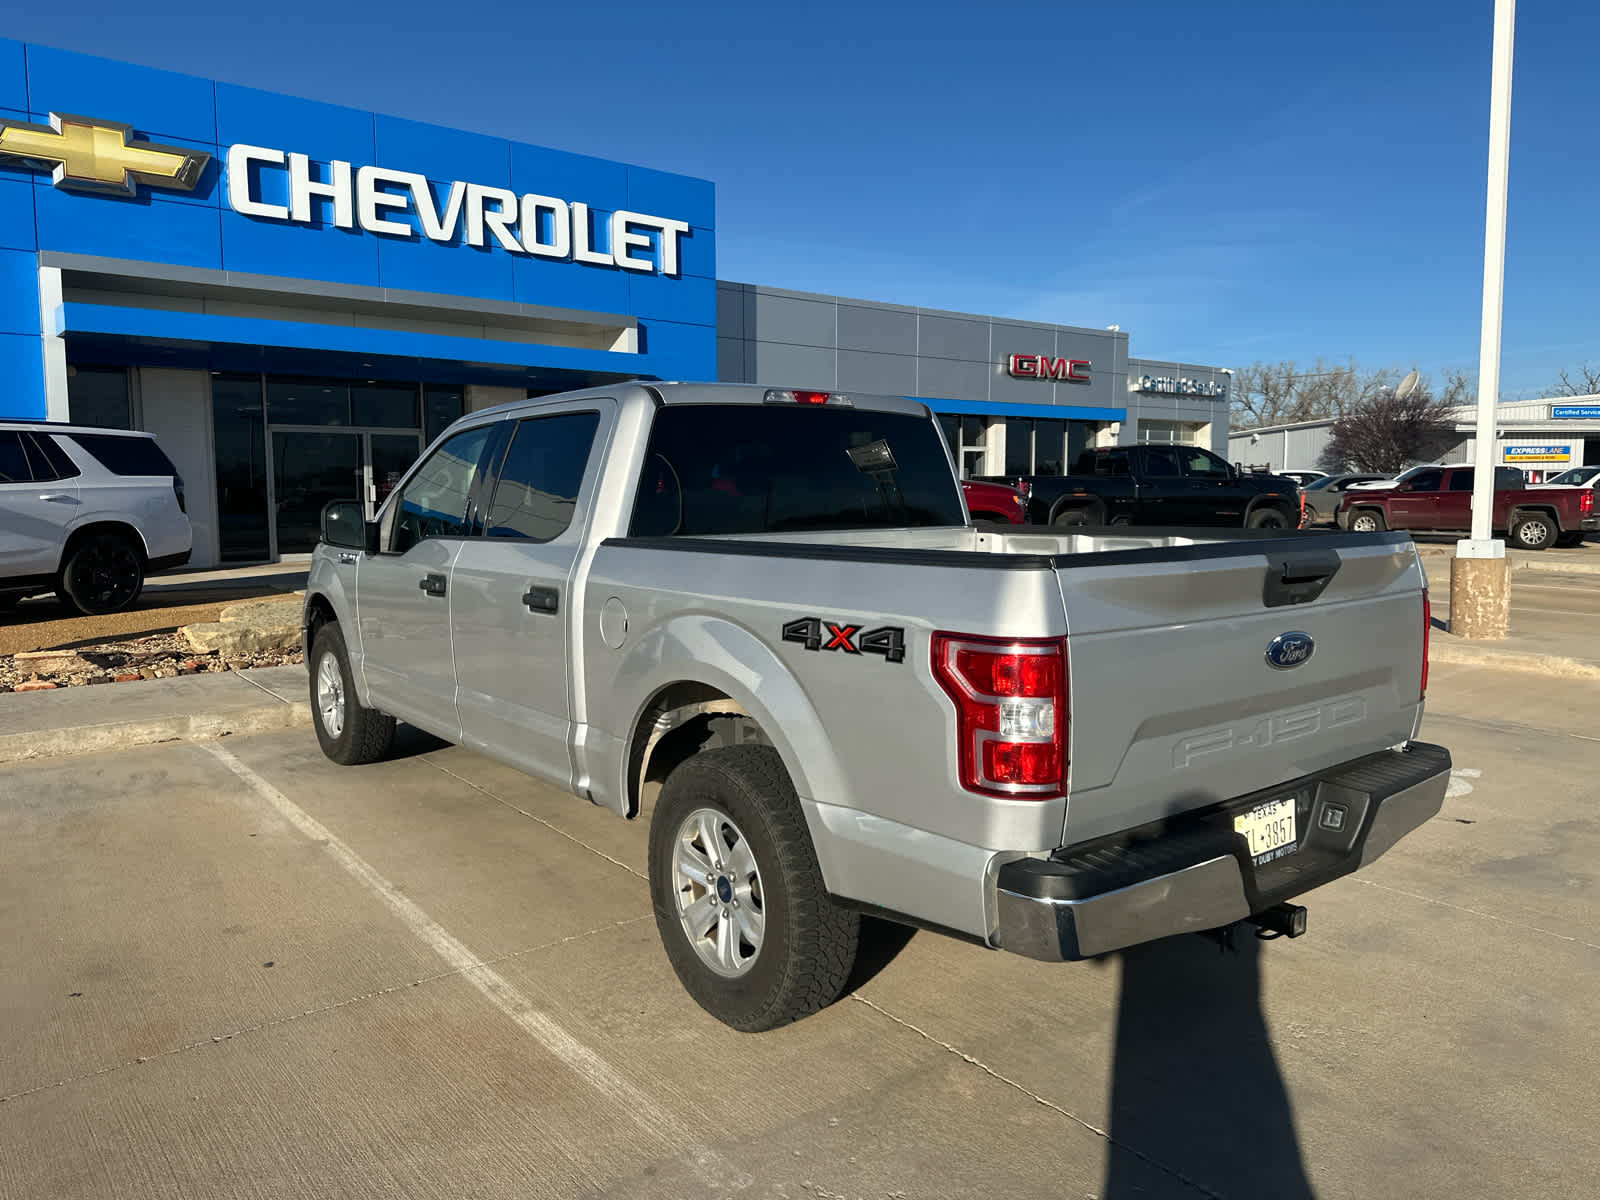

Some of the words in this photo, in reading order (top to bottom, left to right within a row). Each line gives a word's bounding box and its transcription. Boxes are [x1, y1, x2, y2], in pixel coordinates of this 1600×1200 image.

[227, 143, 689, 277] CHEVROLET
[1009, 354, 1092, 382] GMC
[1142, 374, 1187, 393] Certified
[1191, 379, 1227, 397] Service
[1279, 640, 1308, 662] Ford
[1171, 696, 1368, 769] F-150
